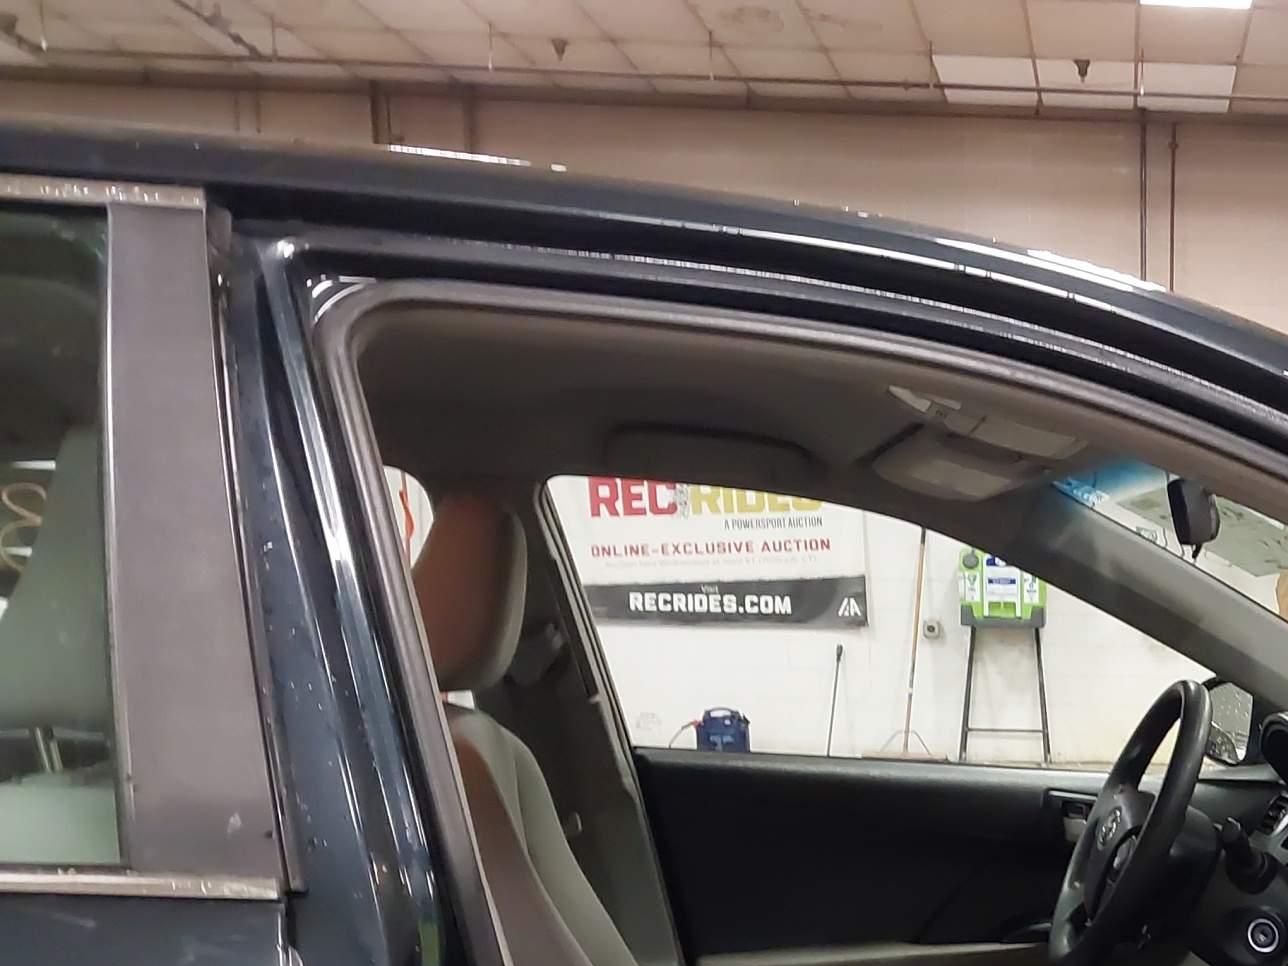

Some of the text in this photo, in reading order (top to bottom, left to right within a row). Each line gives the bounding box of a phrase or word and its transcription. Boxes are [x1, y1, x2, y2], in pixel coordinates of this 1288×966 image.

[732, 517, 786, 529] POWERSPORT
[788, 515, 823, 528] AUCTION
[591, 537, 831, 558] ONLINE-EXCLUSIVE AUCTION
[628, 591, 792, 615] RECRIDES.COM
